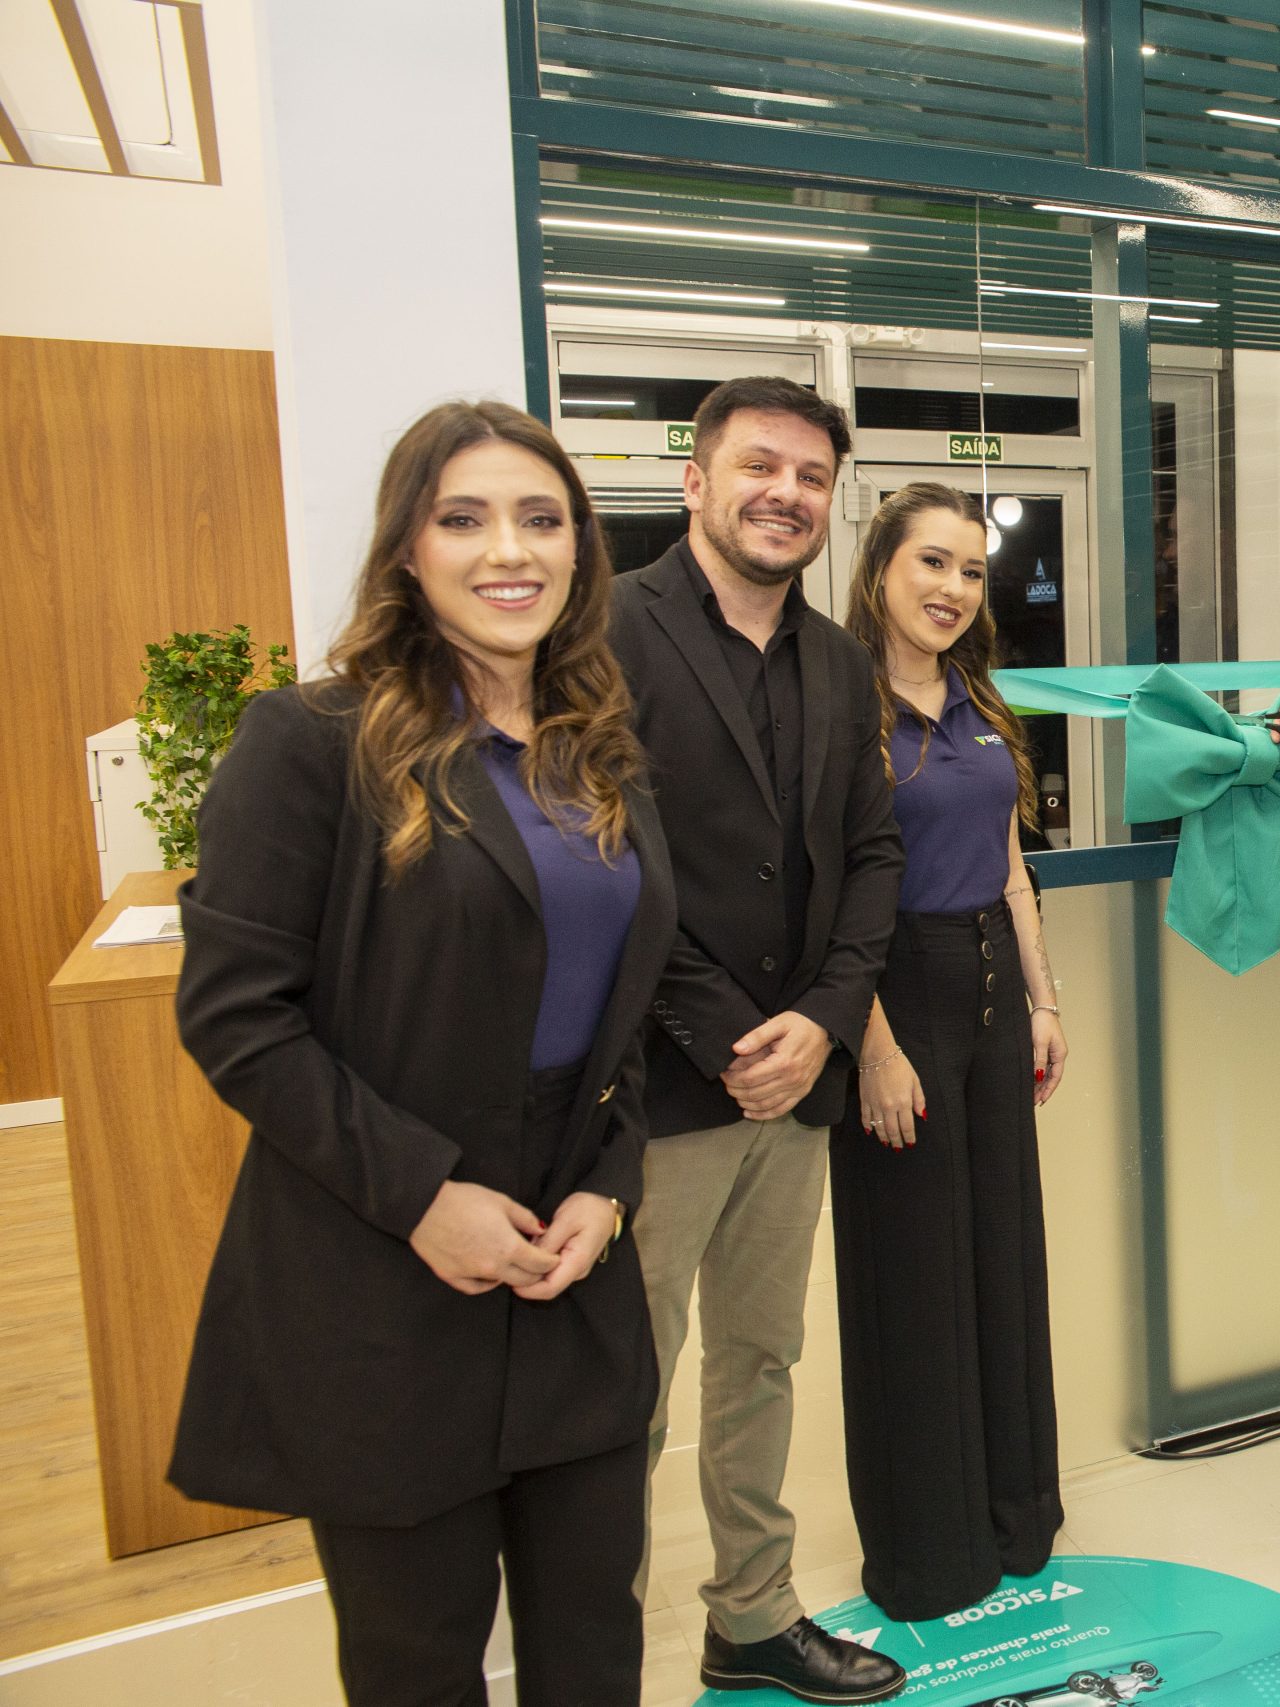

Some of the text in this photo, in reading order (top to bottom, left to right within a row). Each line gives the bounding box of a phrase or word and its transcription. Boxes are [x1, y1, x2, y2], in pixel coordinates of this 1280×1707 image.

[951, 438, 999, 455] SAÍDA
[943, 1588, 1048, 1627] SICOOB
[1031, 1623, 1071, 1641] mais
[1050, 1625, 1111, 1649] Quanto
[960, 1636, 1028, 1663] chances
[1009, 1645, 1047, 1662] mais
[931, 1658, 1006, 1687] produtos
[935, 1658, 958, 1671] de
